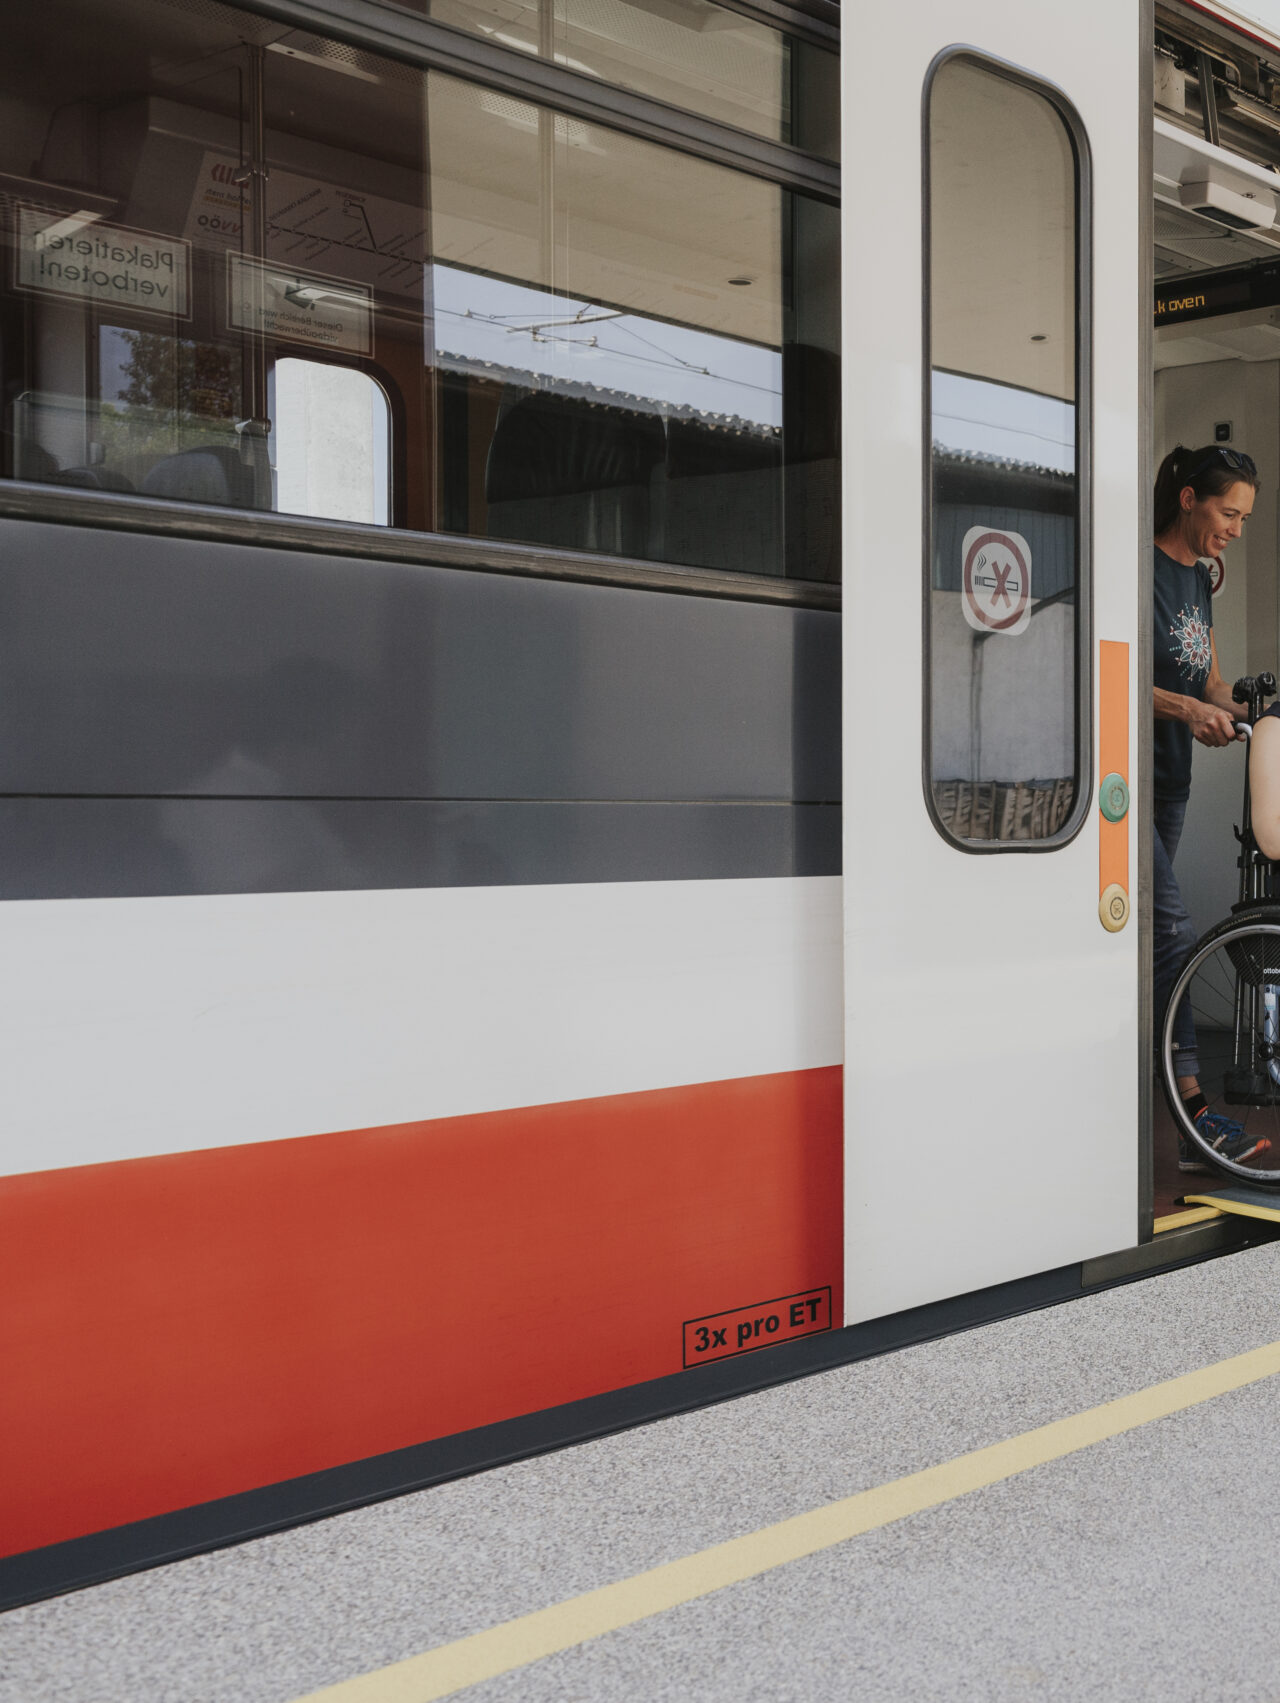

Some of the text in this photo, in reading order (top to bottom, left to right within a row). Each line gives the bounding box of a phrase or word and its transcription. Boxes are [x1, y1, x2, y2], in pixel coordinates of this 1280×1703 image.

[694, 1297, 822, 1353] 3x pro ET
